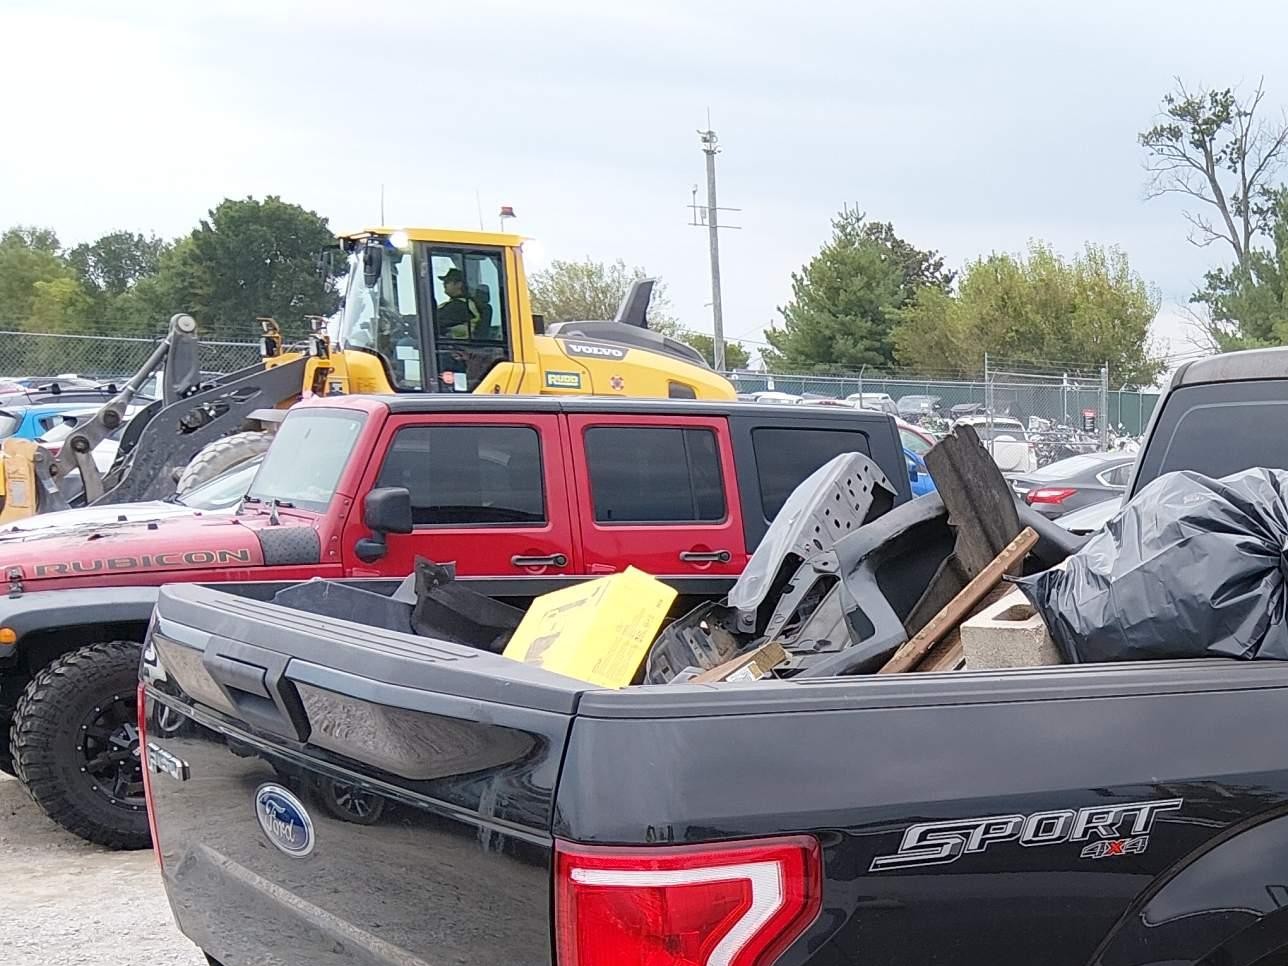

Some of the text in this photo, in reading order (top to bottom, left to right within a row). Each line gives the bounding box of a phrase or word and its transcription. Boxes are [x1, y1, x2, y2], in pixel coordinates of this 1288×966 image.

[569, 344, 623, 357] VOLVO
[547, 374, 579, 386] RUDD
[35, 549, 250, 577] RUBICON
[264, 798, 296, 843] Ford
[868, 798, 1184, 872] SPORT
